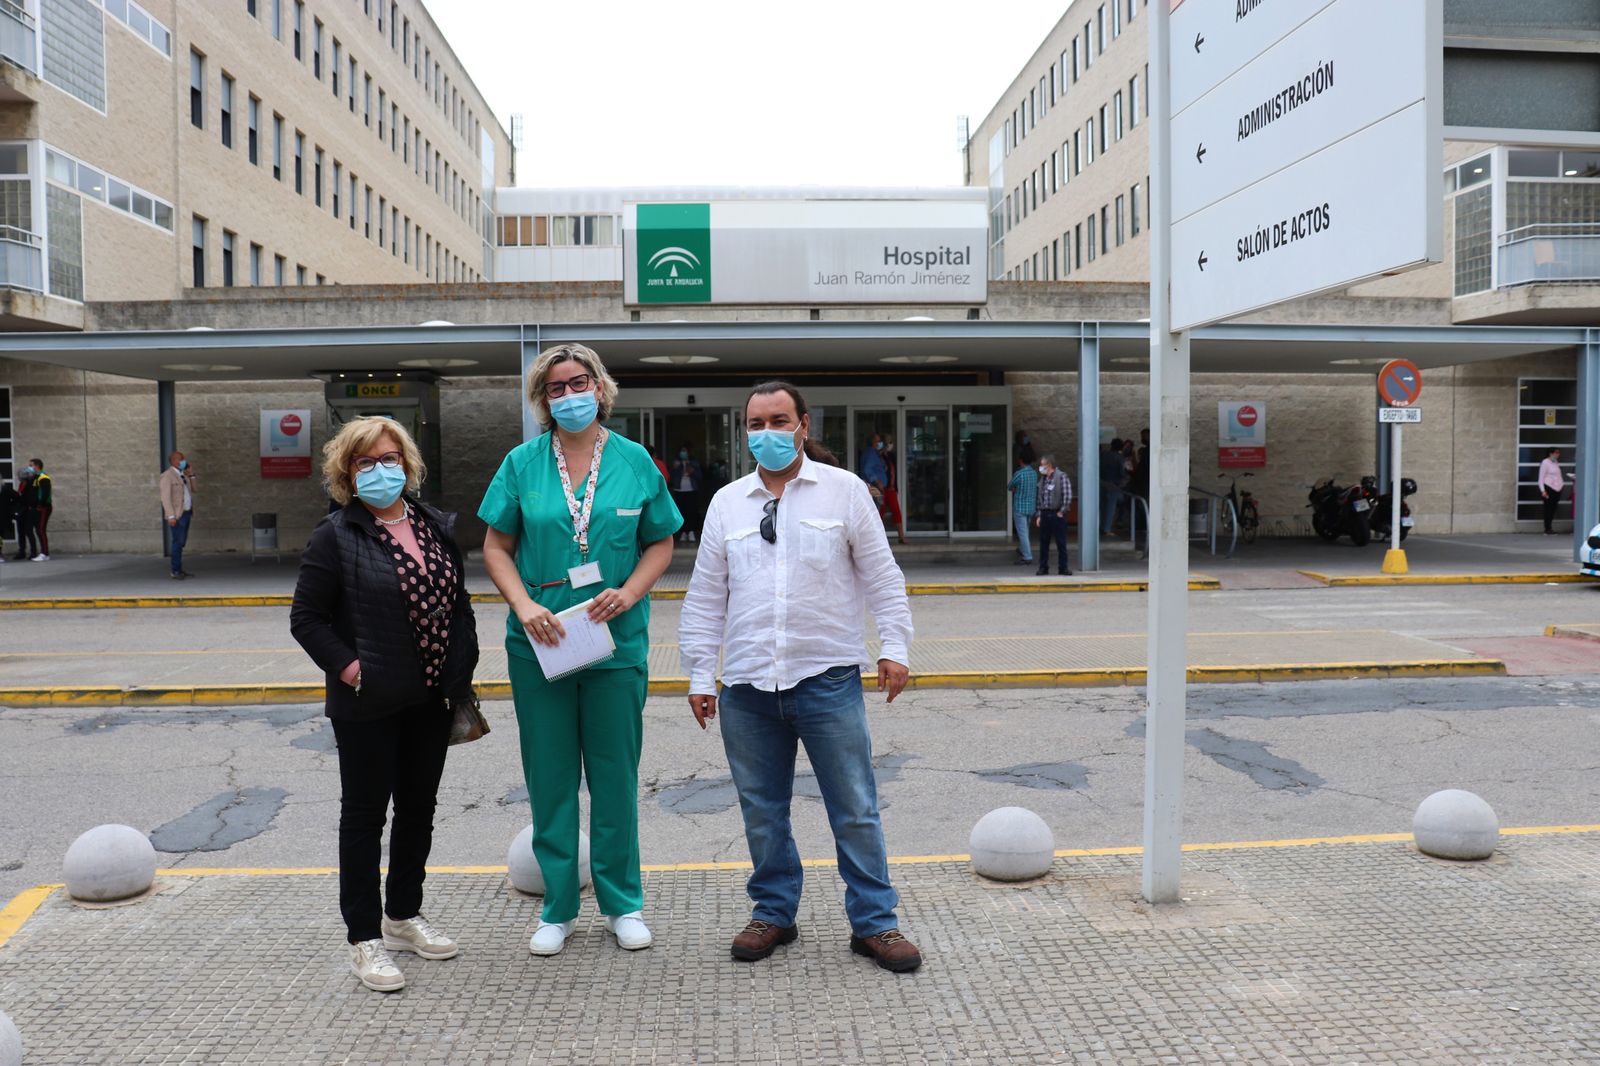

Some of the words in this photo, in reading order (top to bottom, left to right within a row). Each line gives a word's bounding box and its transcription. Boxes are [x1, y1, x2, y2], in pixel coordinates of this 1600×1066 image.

[1237, 60, 1334, 142] ADMINISTRACIÓN
[1237, 224, 1270, 262] SALÓN
[1273, 220, 1287, 248] DE
[1290, 202, 1331, 243] ACTOS
[884, 246, 971, 270] Hospital
[814, 271, 848, 285] Juan
[854, 271, 905, 285] Ramón
[911, 271, 971, 285] Jiménez
[361, 386, 396, 395] ONCE
